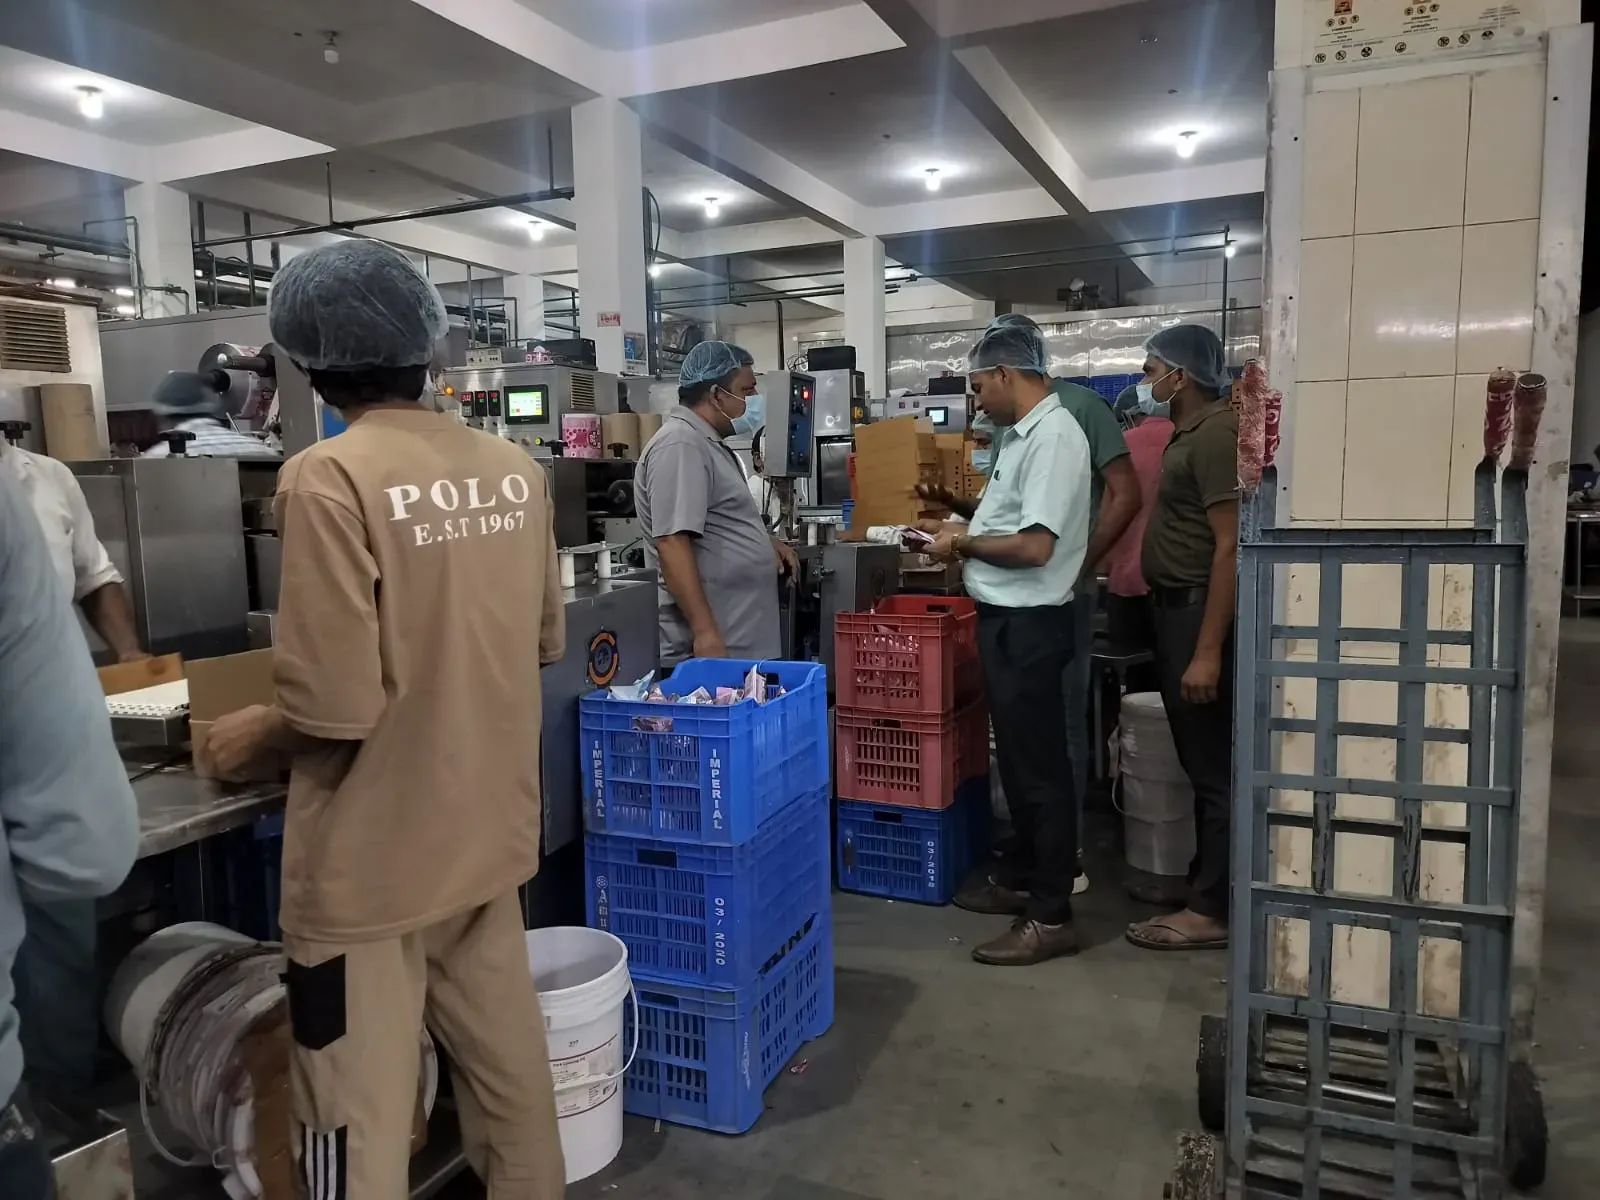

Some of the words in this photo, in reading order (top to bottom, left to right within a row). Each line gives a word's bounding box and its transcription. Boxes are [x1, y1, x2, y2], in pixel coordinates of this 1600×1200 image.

[383, 474, 530, 521] POLO
[479, 510, 525, 535] 1967
[592, 740, 605, 818] IMPERIAL
[709, 748, 723, 830] IMPERIAL
[714, 896, 727, 966] 03/2020
